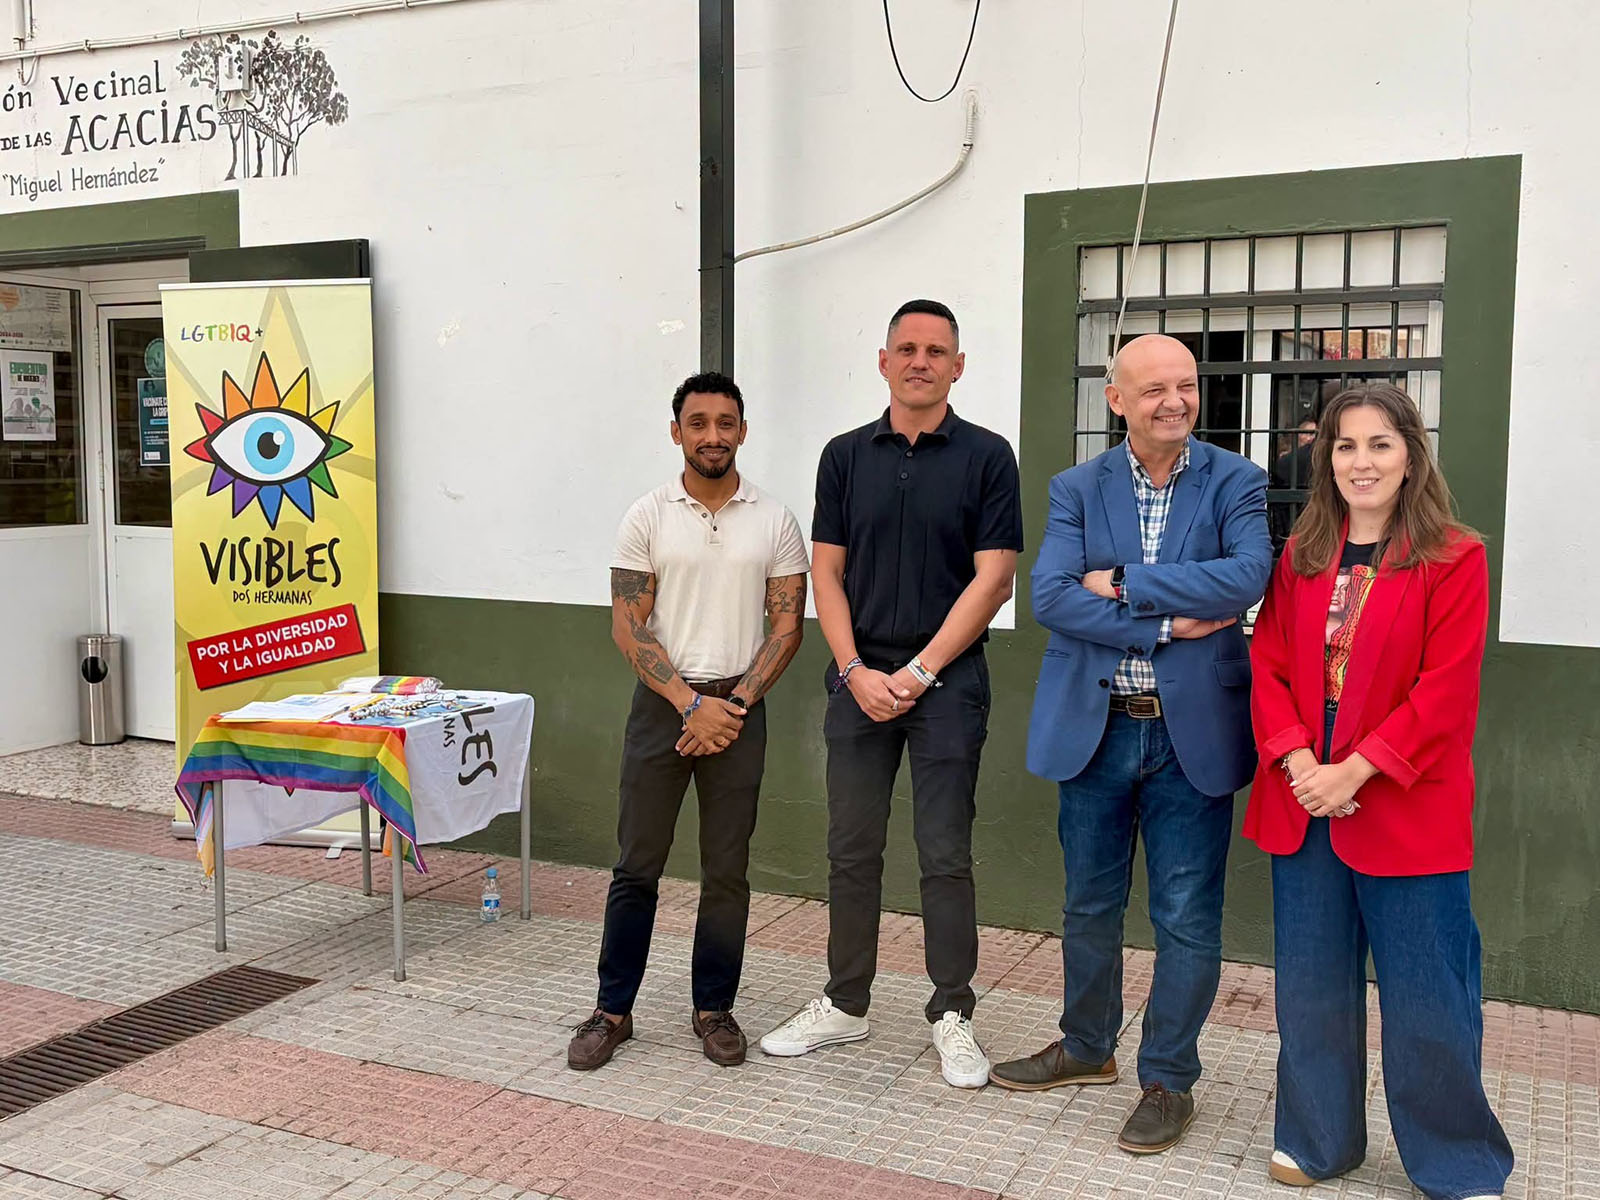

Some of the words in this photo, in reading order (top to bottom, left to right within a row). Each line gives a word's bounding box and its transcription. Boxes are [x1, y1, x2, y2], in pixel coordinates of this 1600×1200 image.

[3, 84, 32, 112] ón
[51, 59, 167, 106] Vecinal
[0, 136, 20, 151] DE
[25, 131, 52, 148] LAS
[200, 536, 342, 589] VISIBLES
[232, 589, 251, 604] DOS
[254, 590, 313, 606] HERMANAS
[197, 642, 230, 661] POR
[232, 639, 253, 653] LA
[255, 613, 348, 647] DIVERSIDAD
[218, 660, 229, 674] Y
[233, 656, 253, 671] LA
[256, 636, 336, 667] IGUALDAD
